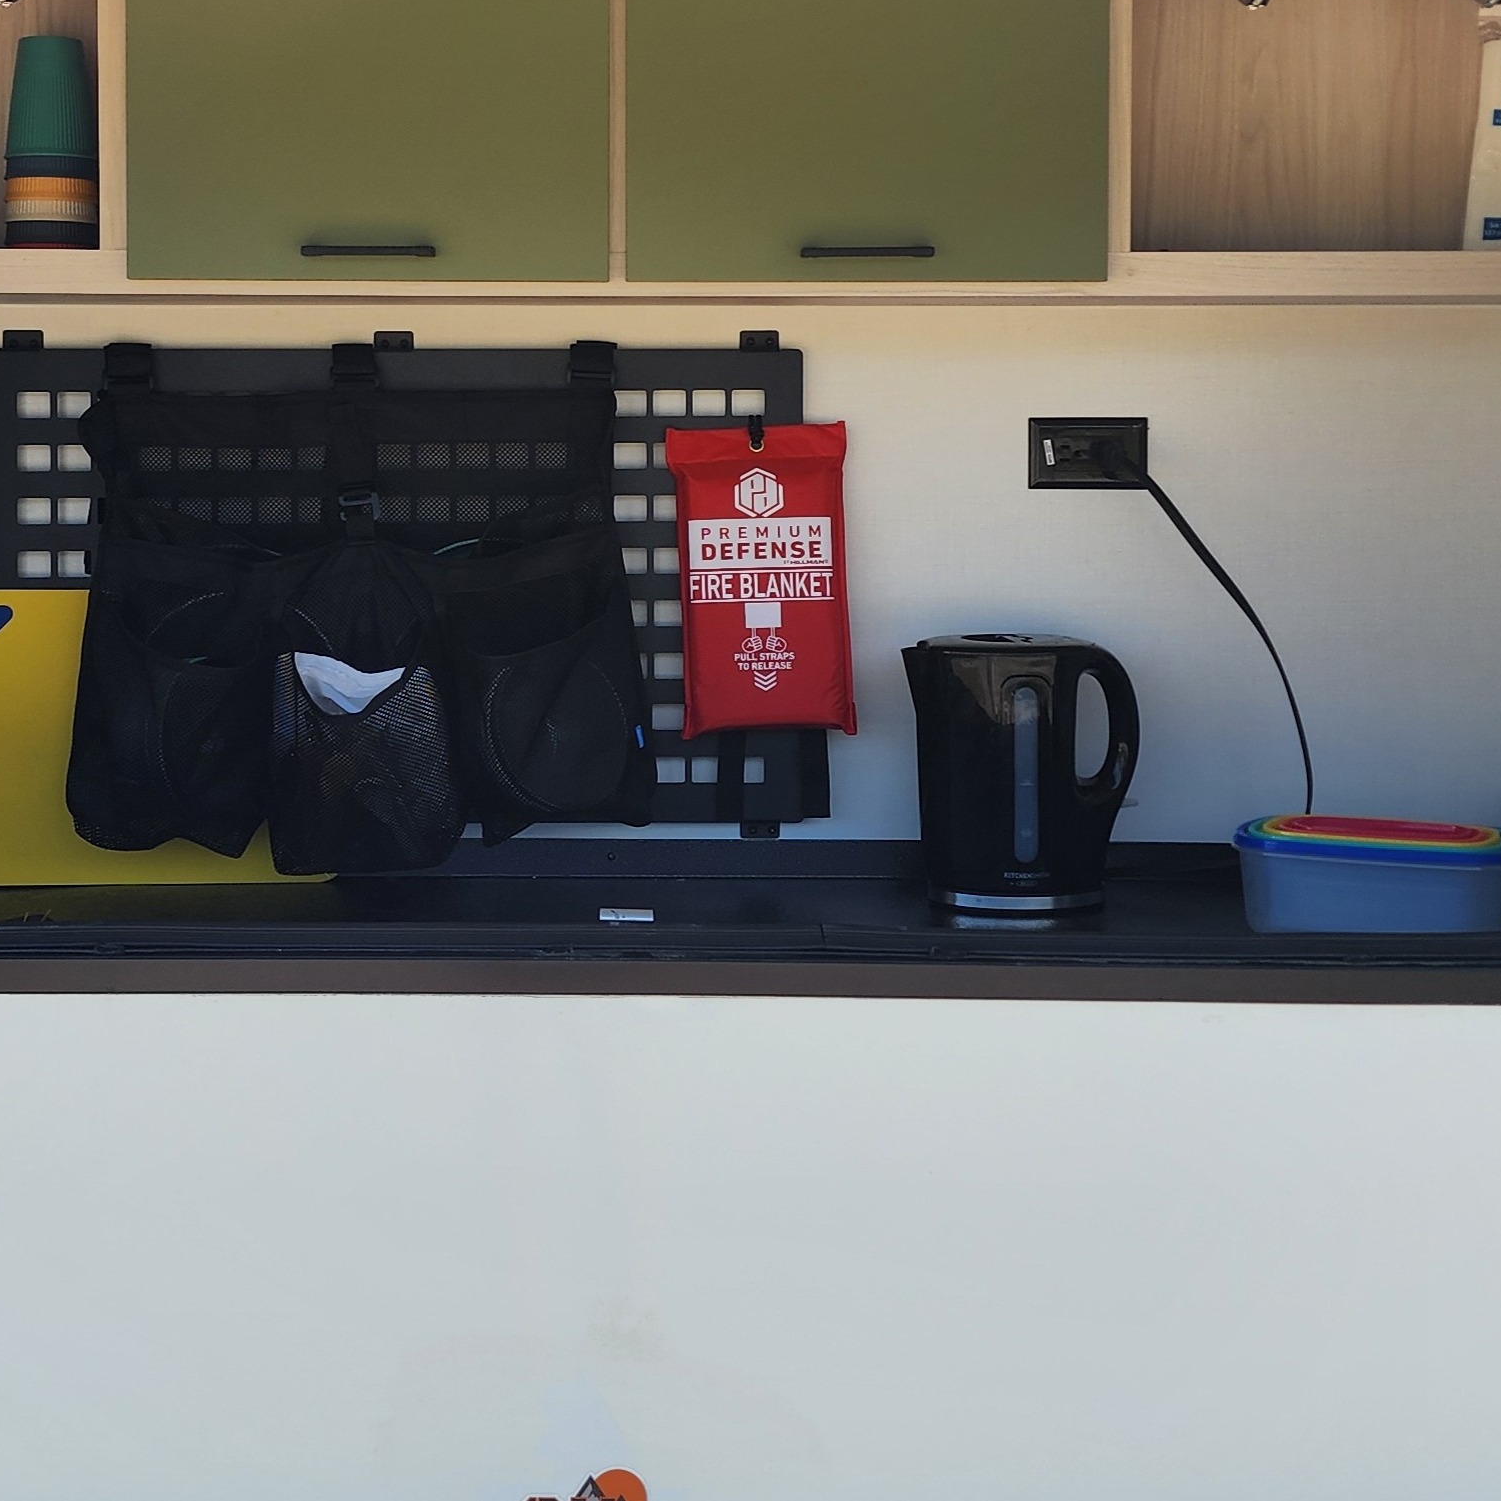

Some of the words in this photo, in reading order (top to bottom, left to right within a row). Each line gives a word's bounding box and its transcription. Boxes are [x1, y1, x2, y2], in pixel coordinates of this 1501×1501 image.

[701, 525, 821, 540] PREMIUM
[701, 541, 822, 560] DEFENSE
[690, 574, 733, 599] FIRE
[740, 572, 833, 598] BLANKET
[734, 653, 758, 662] PULL
[759, 652, 795, 661] STRAPS
[737, 662, 750, 671] TO
[751, 661, 793, 671] RELEASE
